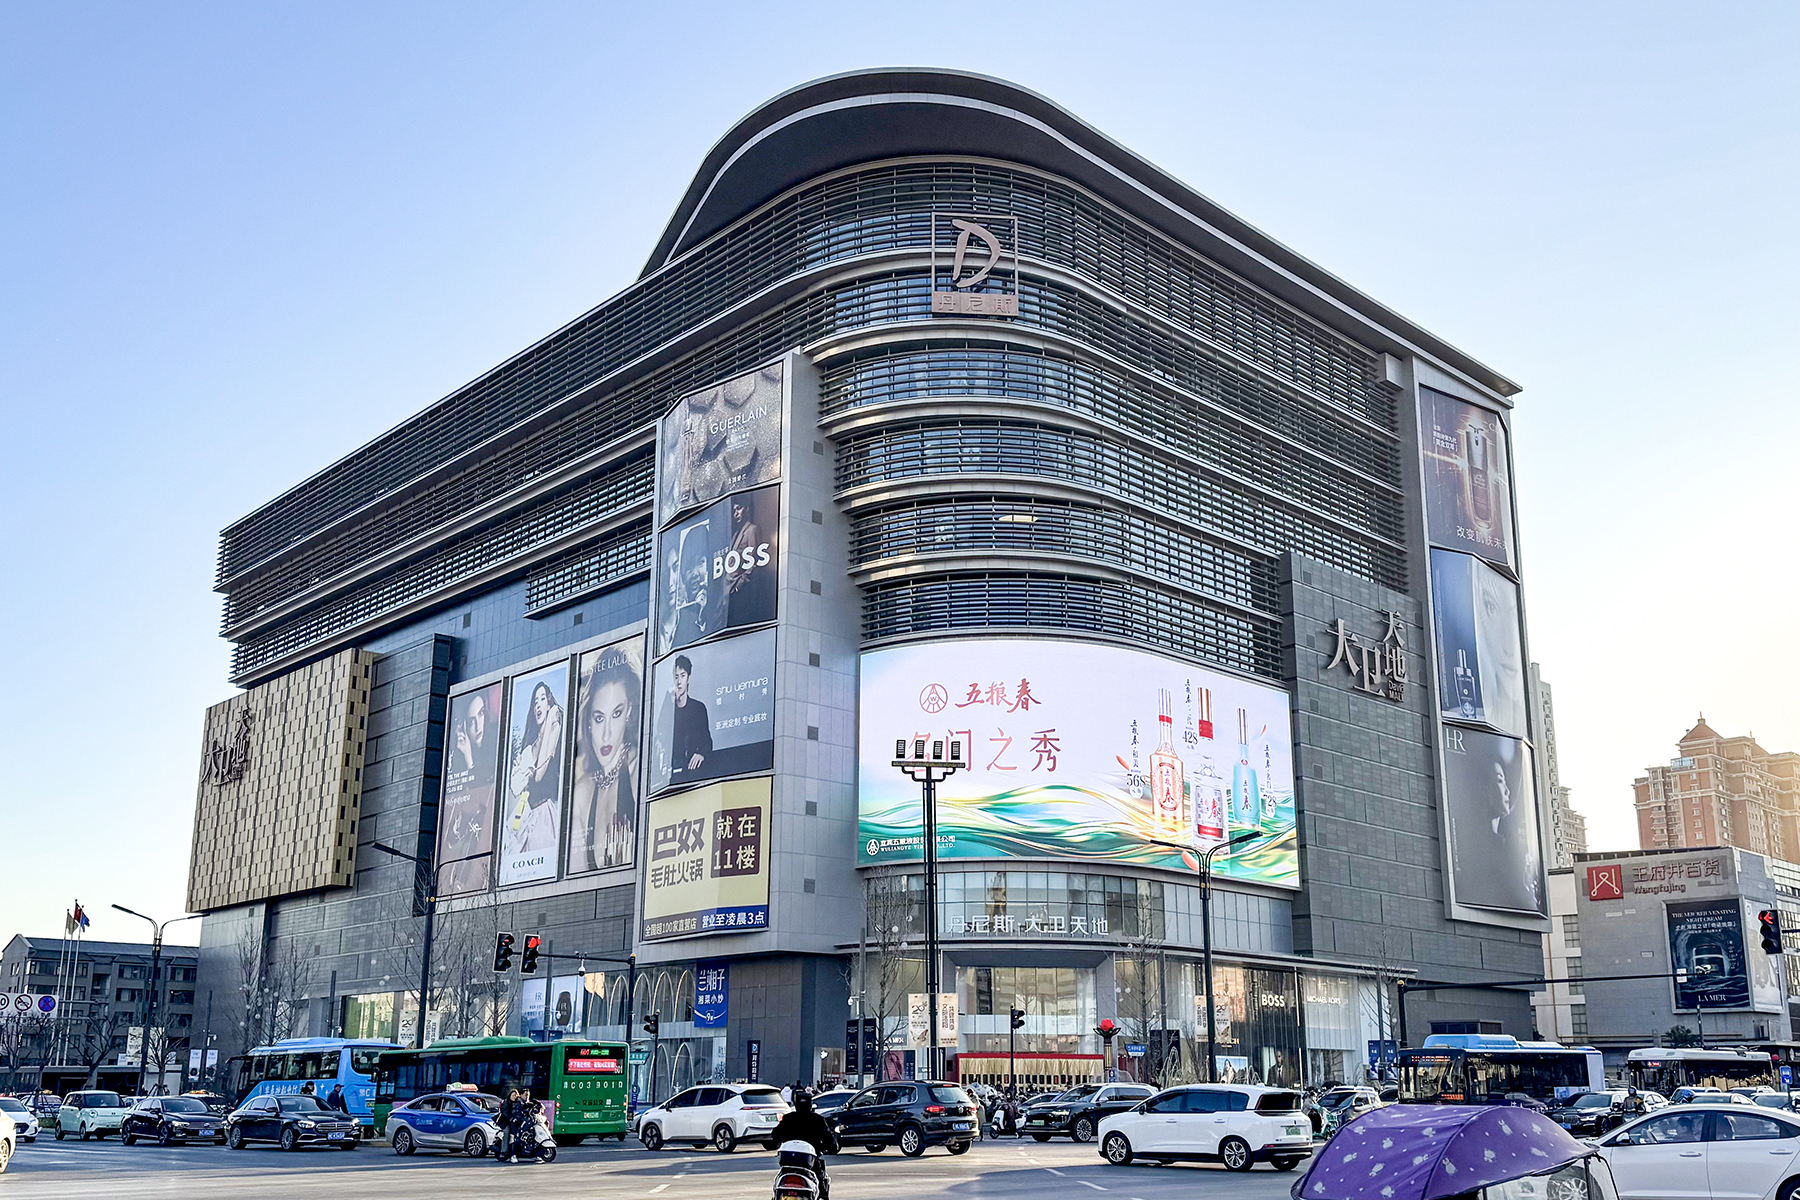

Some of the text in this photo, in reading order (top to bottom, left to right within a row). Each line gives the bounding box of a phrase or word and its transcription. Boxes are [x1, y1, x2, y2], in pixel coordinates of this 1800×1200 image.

[952, 219, 1001, 288] D
[939, 294, 1013, 314] 丹尼斯
[710, 404, 767, 435] GUERLAIN
[712, 543, 770, 580] BOSS
[1325, 608, 1410, 698] 大卫天地
[716, 676, 769, 696] shu uemura
[954, 677, 1042, 714] 五粮春
[715, 711, 768, 731] 亚洲定制 专业底妆
[1182, 730, 1198, 745] 428
[1445, 727, 1467, 752] HR
[1126, 772, 1146, 788] 568
[715, 813, 757, 840] 就在
[651, 817, 705, 862] 巴奴
[512, 856, 545, 870] COACH
[713, 845, 756, 871] 11楼
[650, 857, 704, 889] 毛肚火锅
[1632, 858, 1721, 884] 王府井百货
[1633, 884, 1686, 896] Wangfujing
[644, 917, 697, 937] 全国超100家直营店
[702, 910, 765, 928] 营业至凌晨3点
[947, 914, 1110, 936] 丹尼斯·大卫天地
[698, 968, 726, 991] 兰湘子
[698, 993, 725, 1005] 湘菜小炒
[1261, 993, 1286, 1008] BOSS
[1709, 994, 1727, 1002] MER
